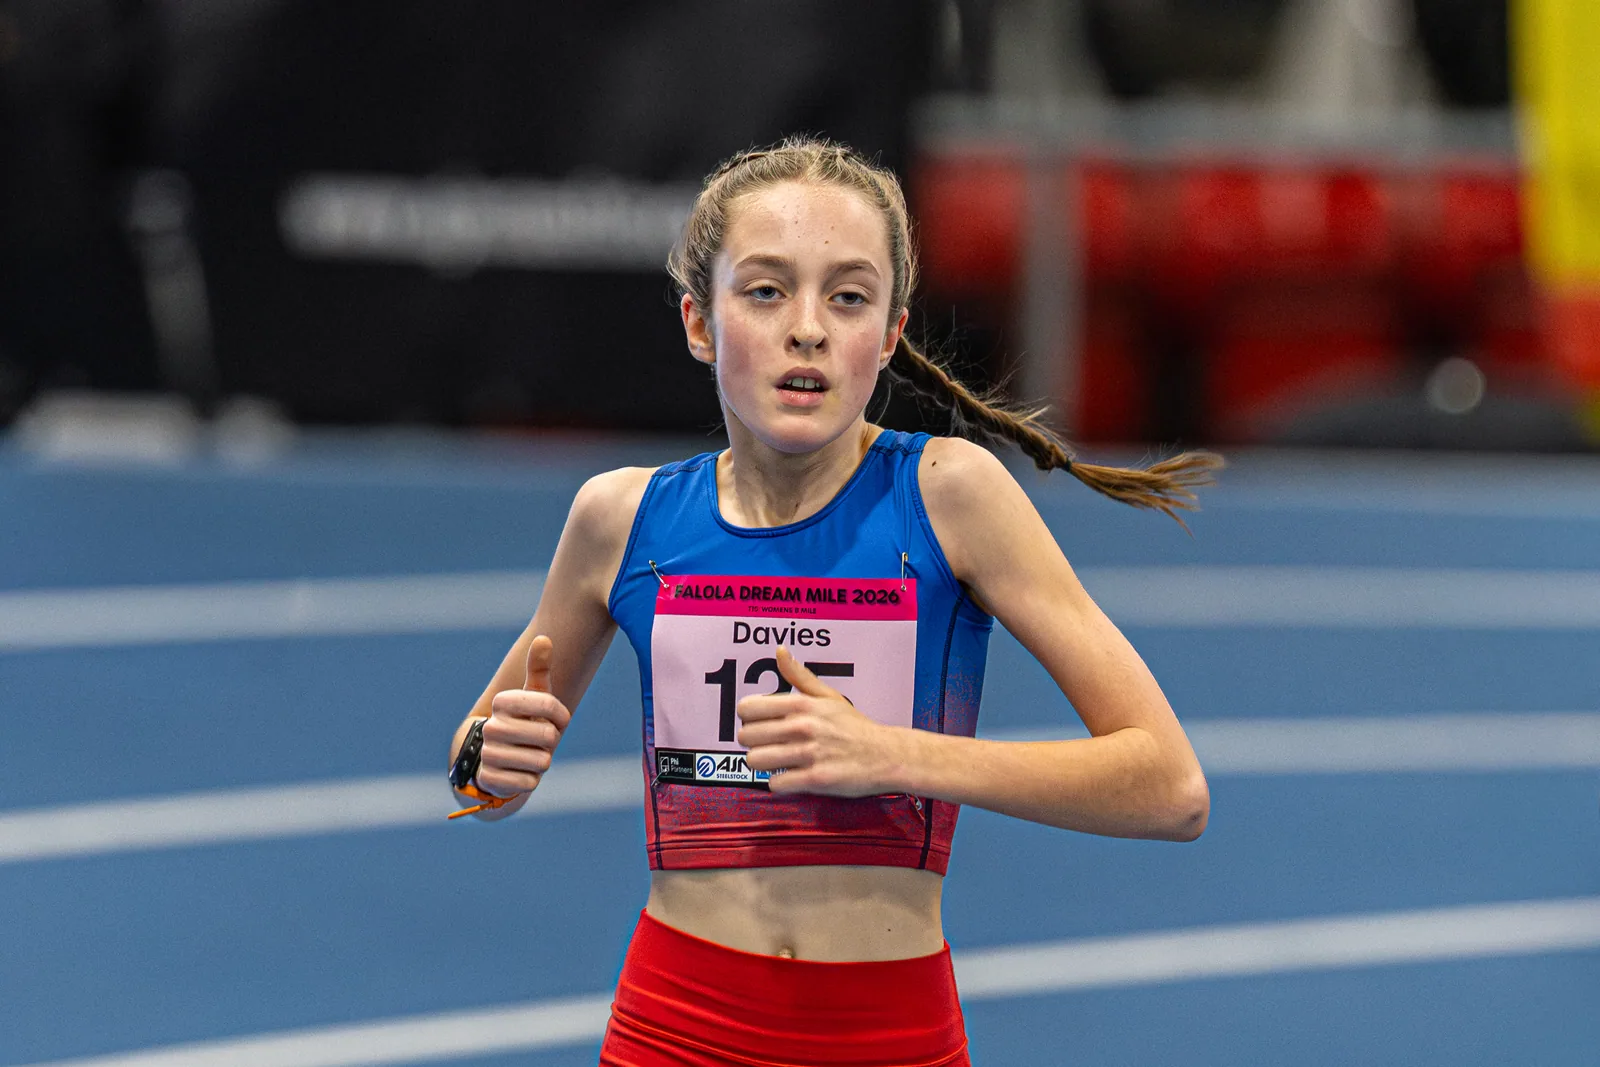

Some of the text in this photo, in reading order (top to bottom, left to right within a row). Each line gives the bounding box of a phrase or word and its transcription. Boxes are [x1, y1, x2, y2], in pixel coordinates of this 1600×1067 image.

[674, 584, 900, 605] FALOLA DREAM MILE 2026
[801, 607, 817, 615] MILE
[733, 621, 831, 647] Davies
